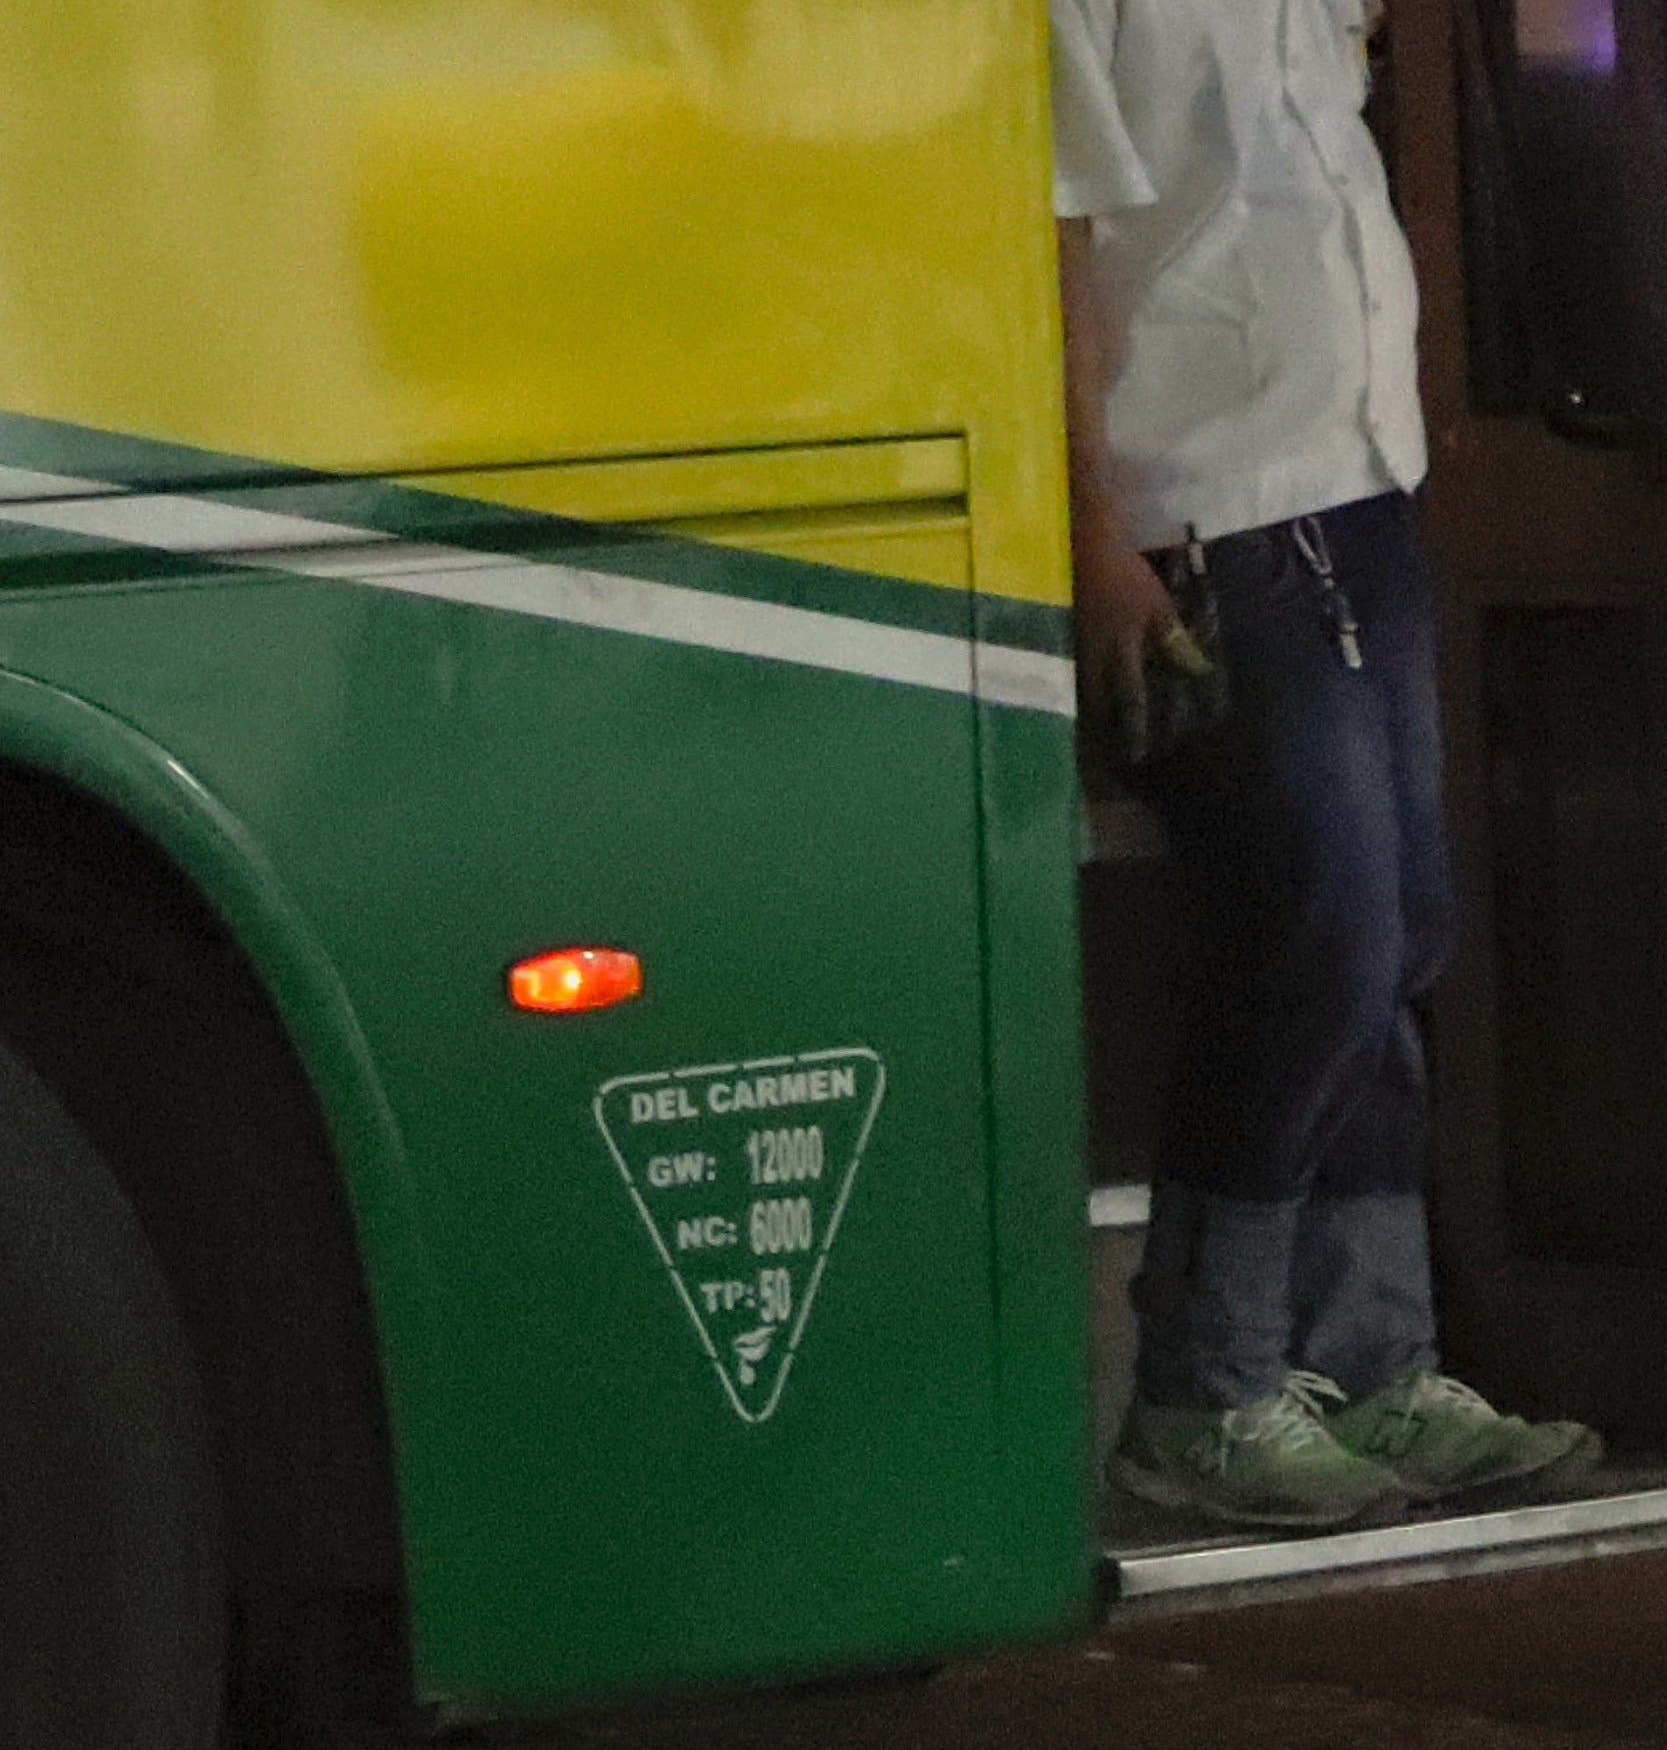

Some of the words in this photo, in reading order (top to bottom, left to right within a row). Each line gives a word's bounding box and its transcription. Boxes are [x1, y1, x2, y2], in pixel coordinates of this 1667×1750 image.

[630, 1087, 699, 1123] DEL
[708, 1067, 855, 1113] CARMEN
[648, 1153, 717, 1187] GW:
[747, 1126, 824, 1185] 12000
[676, 1215, 739, 1251] NC:
[750, 1197, 813, 1256] 6000
[701, 1281, 757, 1314] TP:
[759, 1267, 792, 1323] 50
